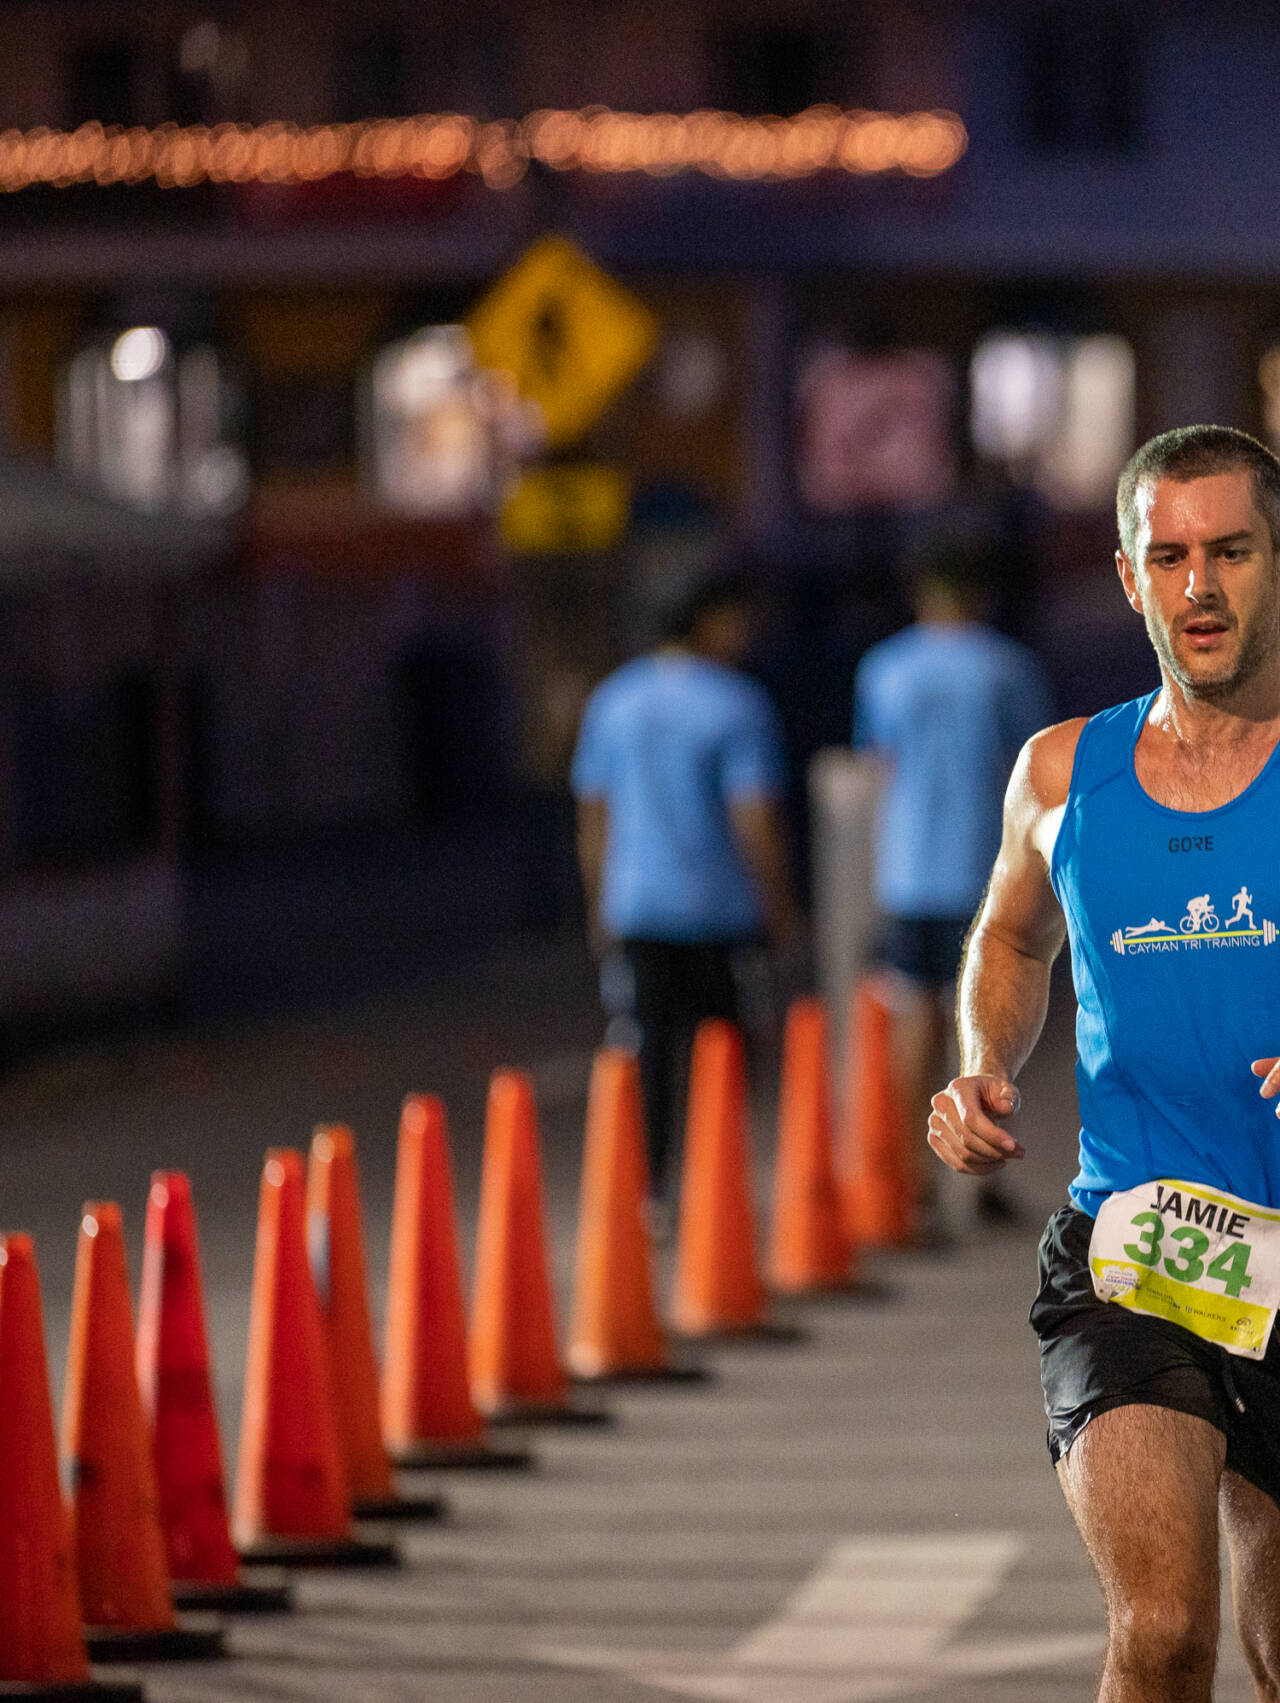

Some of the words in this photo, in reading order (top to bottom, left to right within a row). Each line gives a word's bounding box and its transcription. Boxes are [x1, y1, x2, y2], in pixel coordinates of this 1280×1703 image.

[1168, 835, 1215, 853] GORE
[1128, 940, 1179, 955] CAYMAN
[1182, 939, 1201, 951] TRI
[1204, 935, 1260, 949] TRAINING
[1150, 1185, 1250, 1239] JAMIE
[1123, 1211, 1252, 1299] 334
